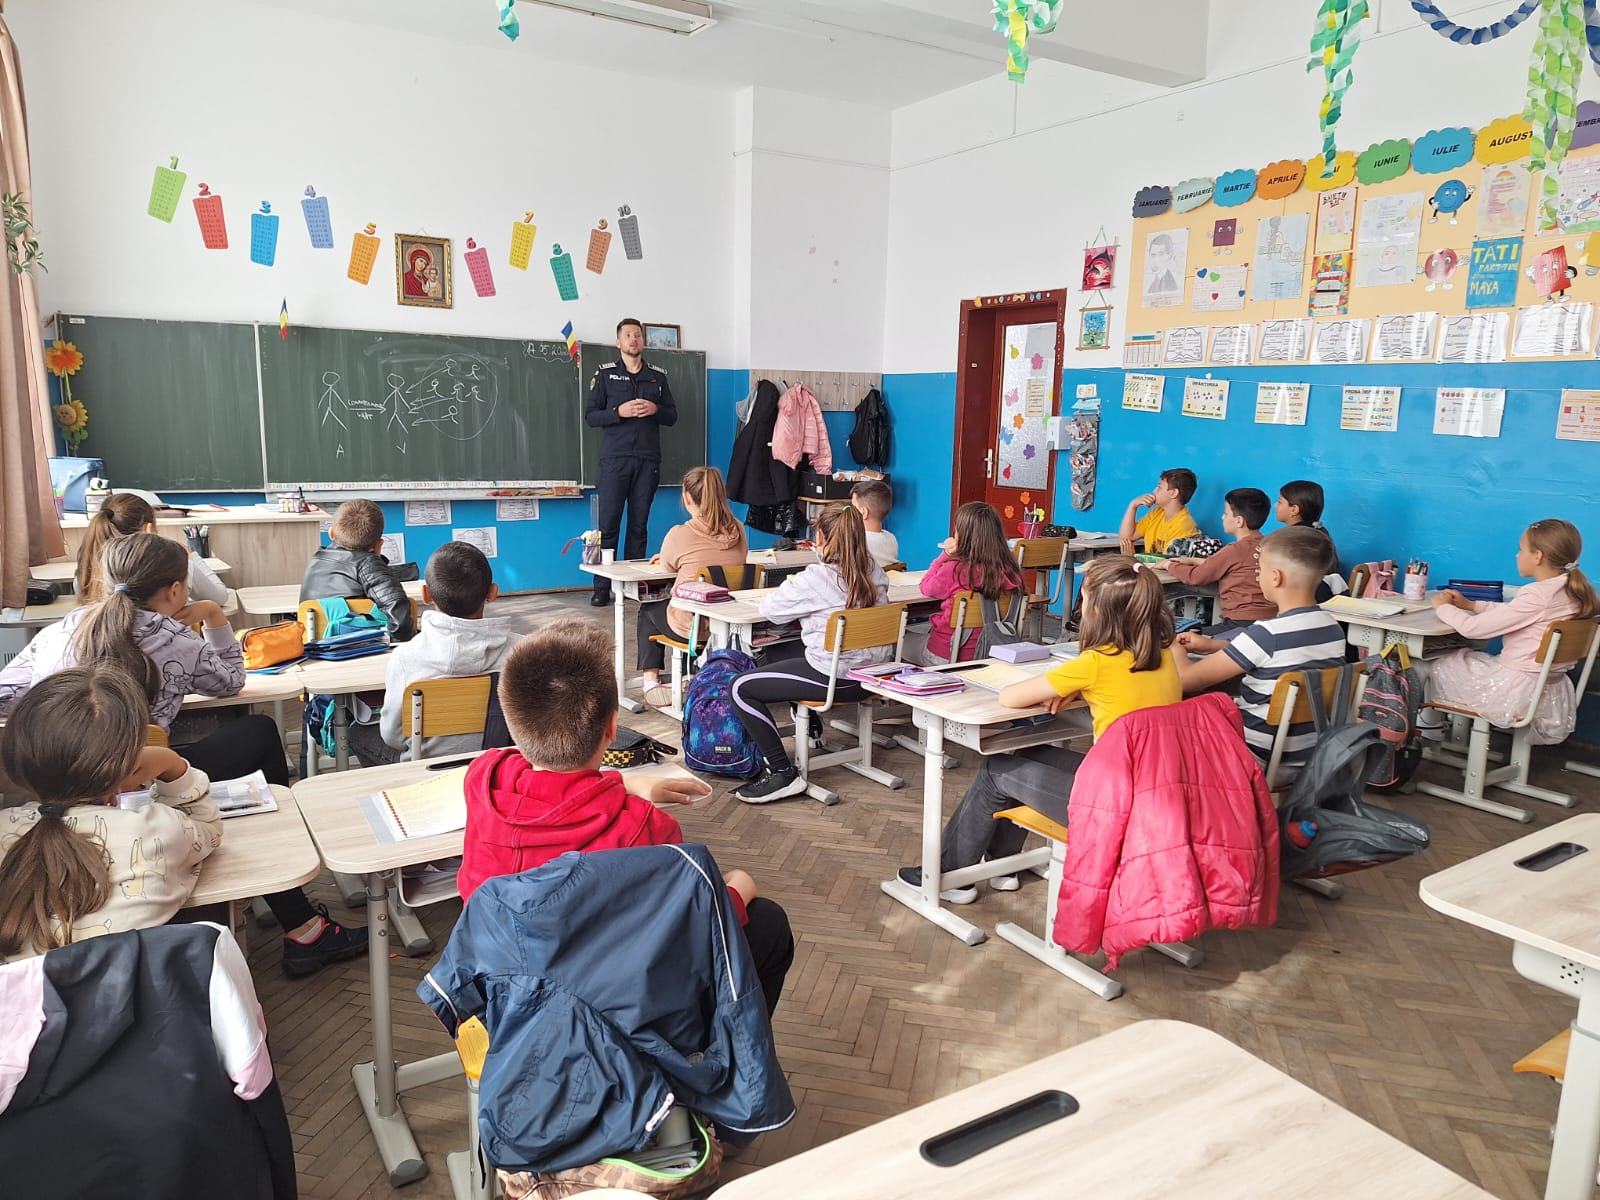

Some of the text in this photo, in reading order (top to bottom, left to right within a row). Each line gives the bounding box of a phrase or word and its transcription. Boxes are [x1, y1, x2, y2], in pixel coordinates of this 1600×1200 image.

[1432, 144, 1460, 156] IULIE
[170, 156, 179, 170] 1
[1374, 154, 1400, 168] IUNIE
[1267, 172, 1299, 186] APRILIE
[198, 183, 211, 196] 2
[304, 185, 316, 198] 4
[1177, 187, 1211, 201] FEBRUARIE
[1223, 182, 1251, 194] MARTIE
[259, 200, 271, 213] 3
[1138, 199, 1168, 207] IANUARIE
[524, 211, 534, 223] 7
[618, 204, 631, 217] 10
[364, 222, 376, 235] 5
[598, 218, 608, 230] 9
[466, 237, 476, 249] 6
[552, 243, 562, 255] 8
[1473, 243, 1519, 263] TATI
[1469, 281, 1499, 295] MAYA
[336, 443, 345, 459] A
